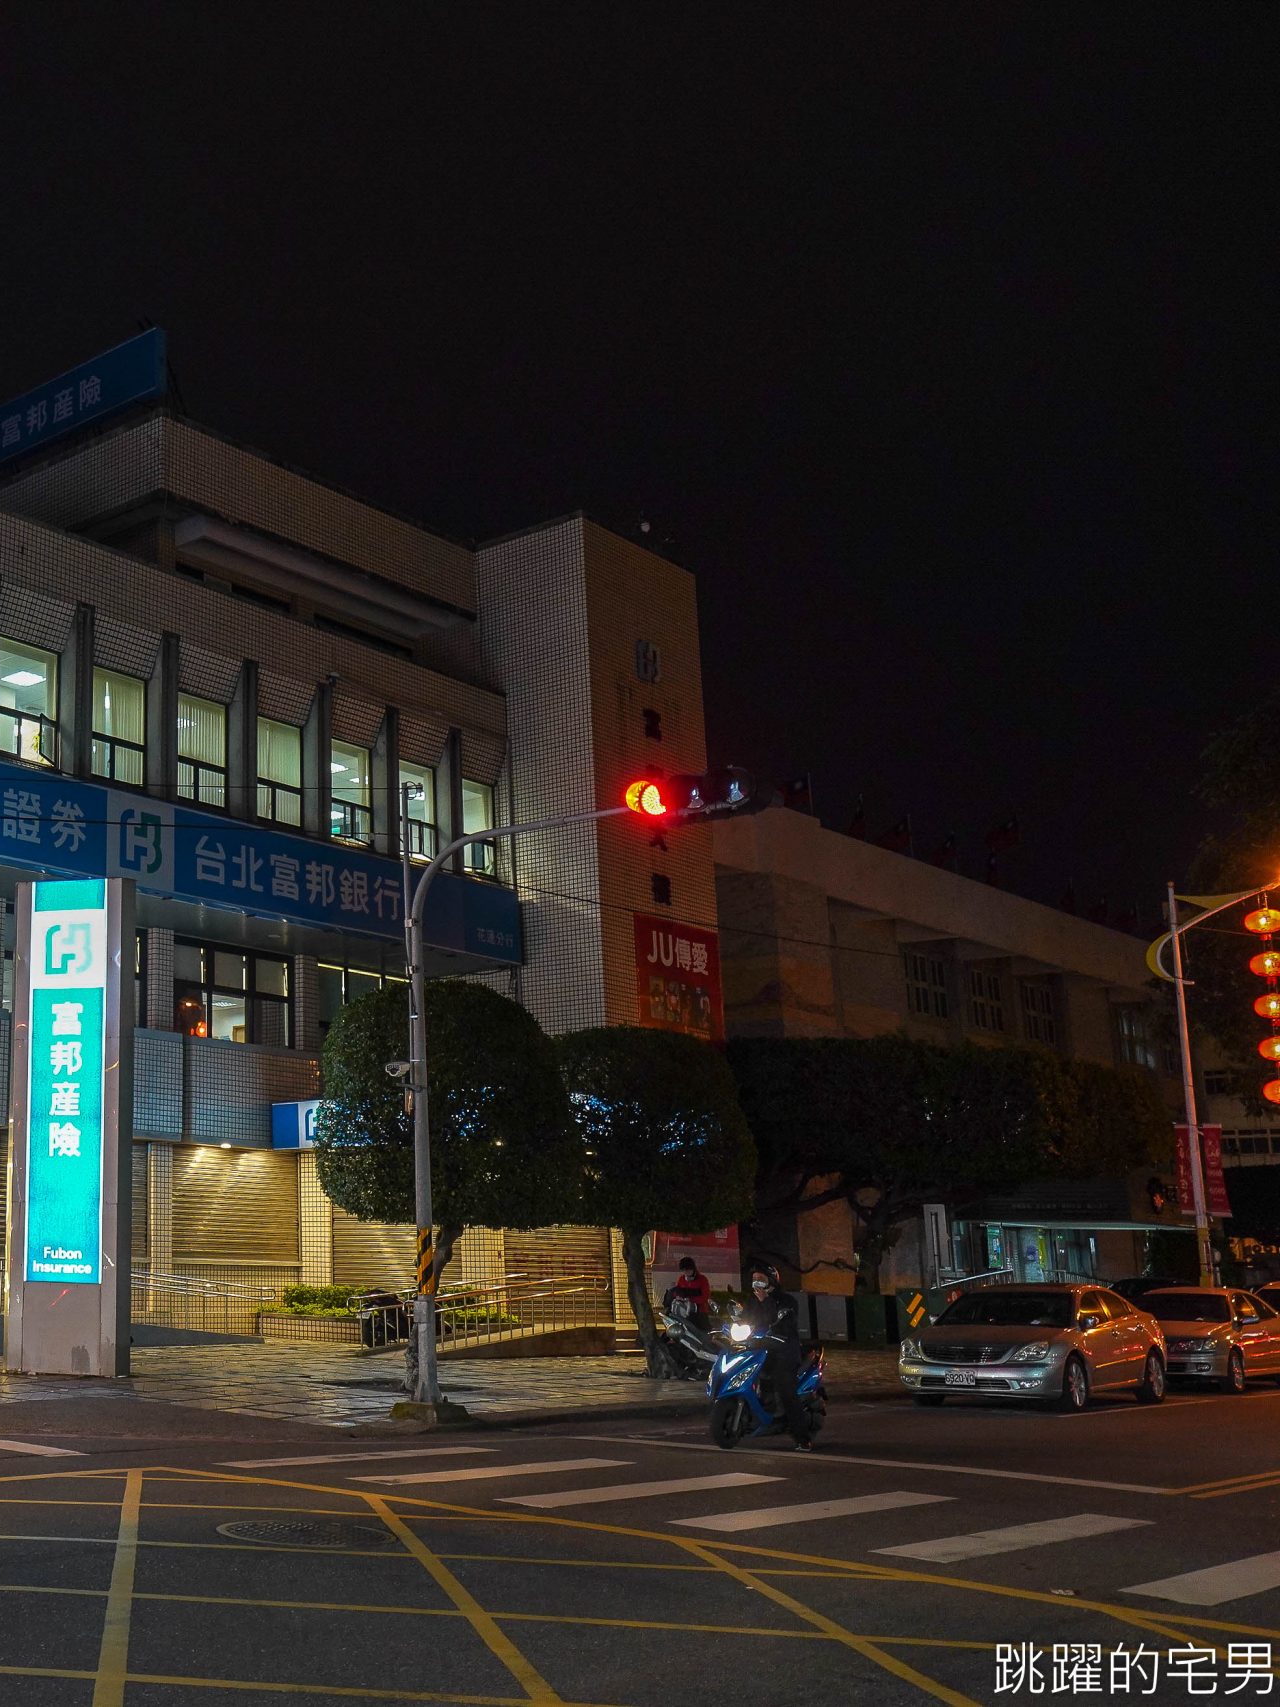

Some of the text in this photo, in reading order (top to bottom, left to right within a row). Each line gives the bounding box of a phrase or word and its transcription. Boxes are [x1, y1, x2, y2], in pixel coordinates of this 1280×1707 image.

[195, 835, 401, 921] 台北富邦銀行
[647, 930, 709, 976] JU傳愛
[32, 1259, 92, 1274] Insurance
[43, 1246, 82, 1259] Fubon
